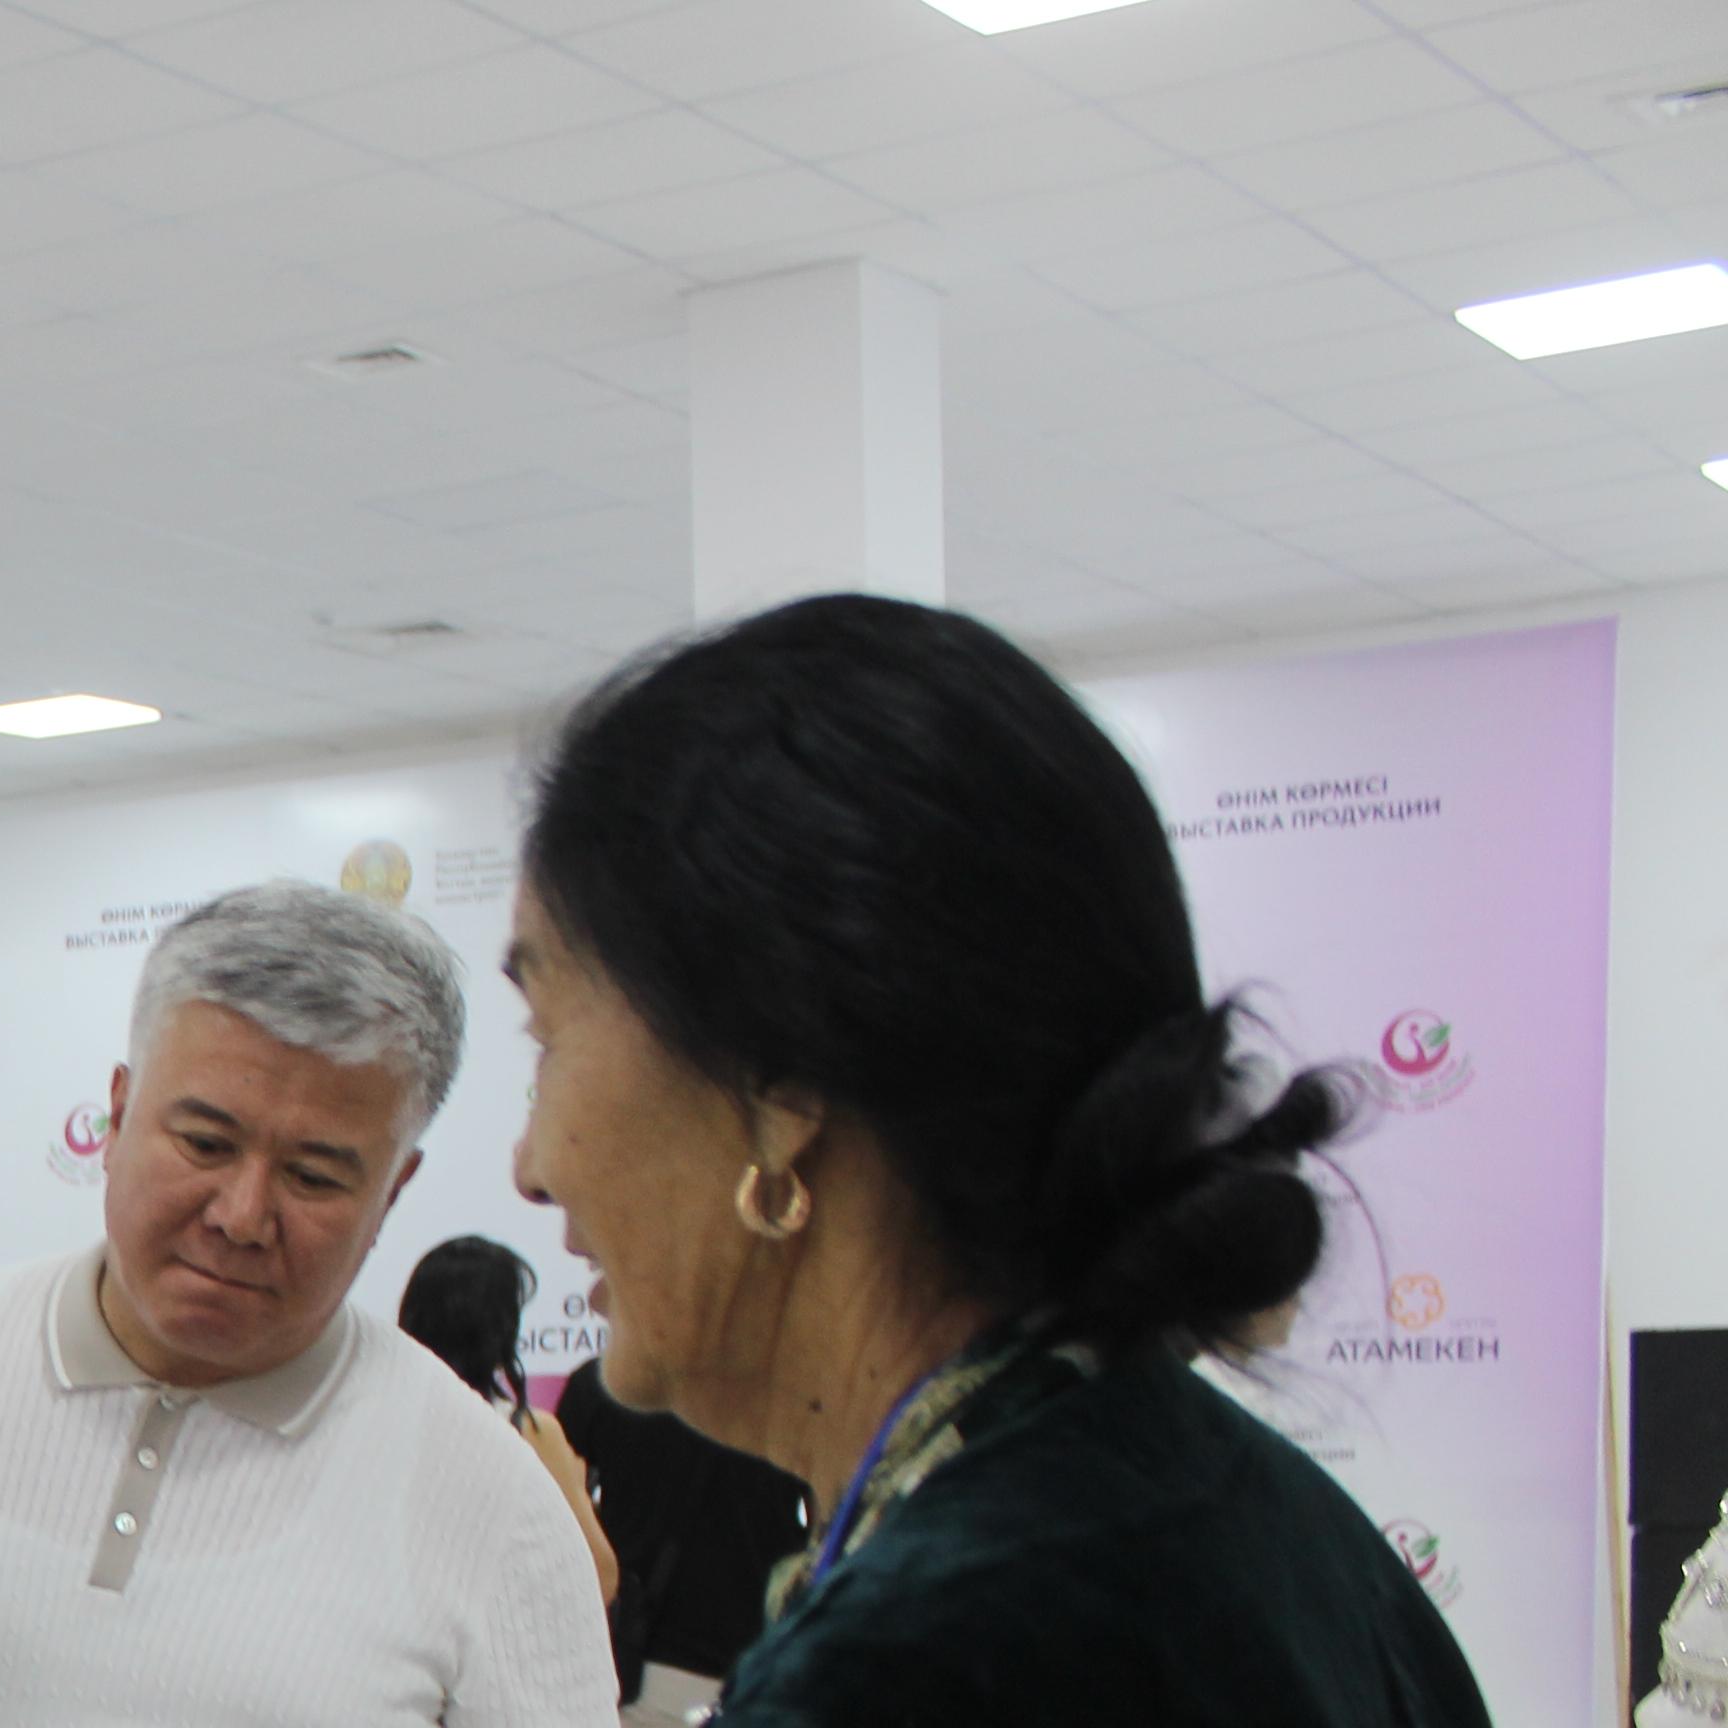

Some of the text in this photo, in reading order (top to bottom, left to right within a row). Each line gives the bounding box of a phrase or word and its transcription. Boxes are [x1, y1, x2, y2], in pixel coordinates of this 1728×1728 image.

[1216, 774, 1388, 810] ӨНІМ КӨРМЕСІ
[1167, 797, 1441, 839] ВЫСТАВКА ПРОДУКЦИИ
[65, 927, 149, 950] ВЫСТАВКА
[1327, 1337, 1501, 1364] АТАМЕКЕН
